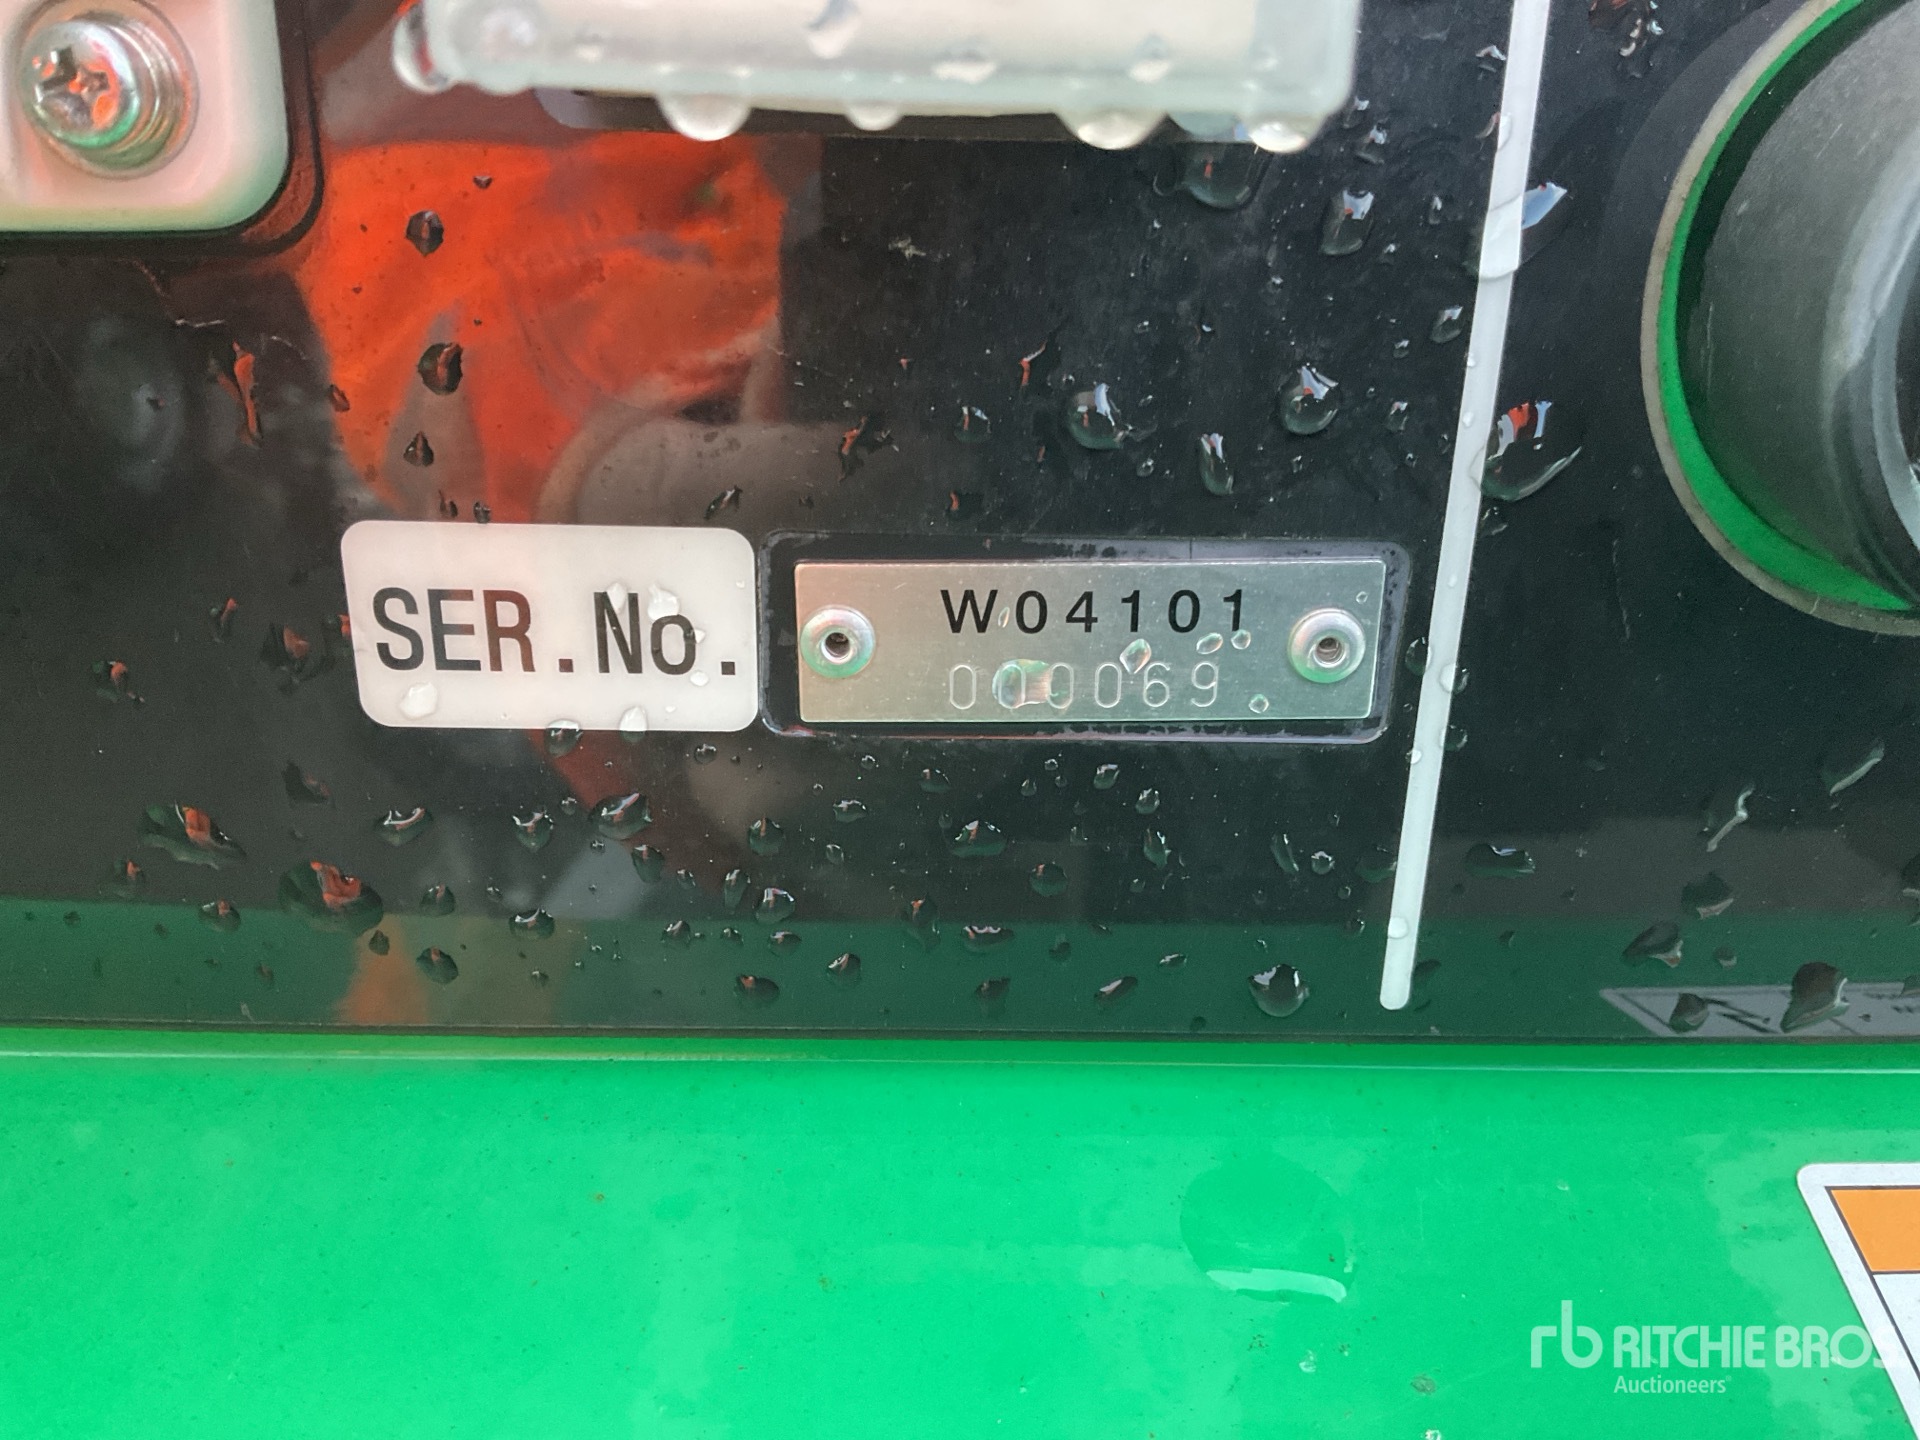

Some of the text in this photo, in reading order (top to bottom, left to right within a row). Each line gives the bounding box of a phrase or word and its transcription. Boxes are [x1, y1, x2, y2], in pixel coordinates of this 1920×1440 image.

[372, 587, 736, 675] SER. No.
[940, 588, 1245, 635] W04101
[948, 661, 1221, 711] 000069
